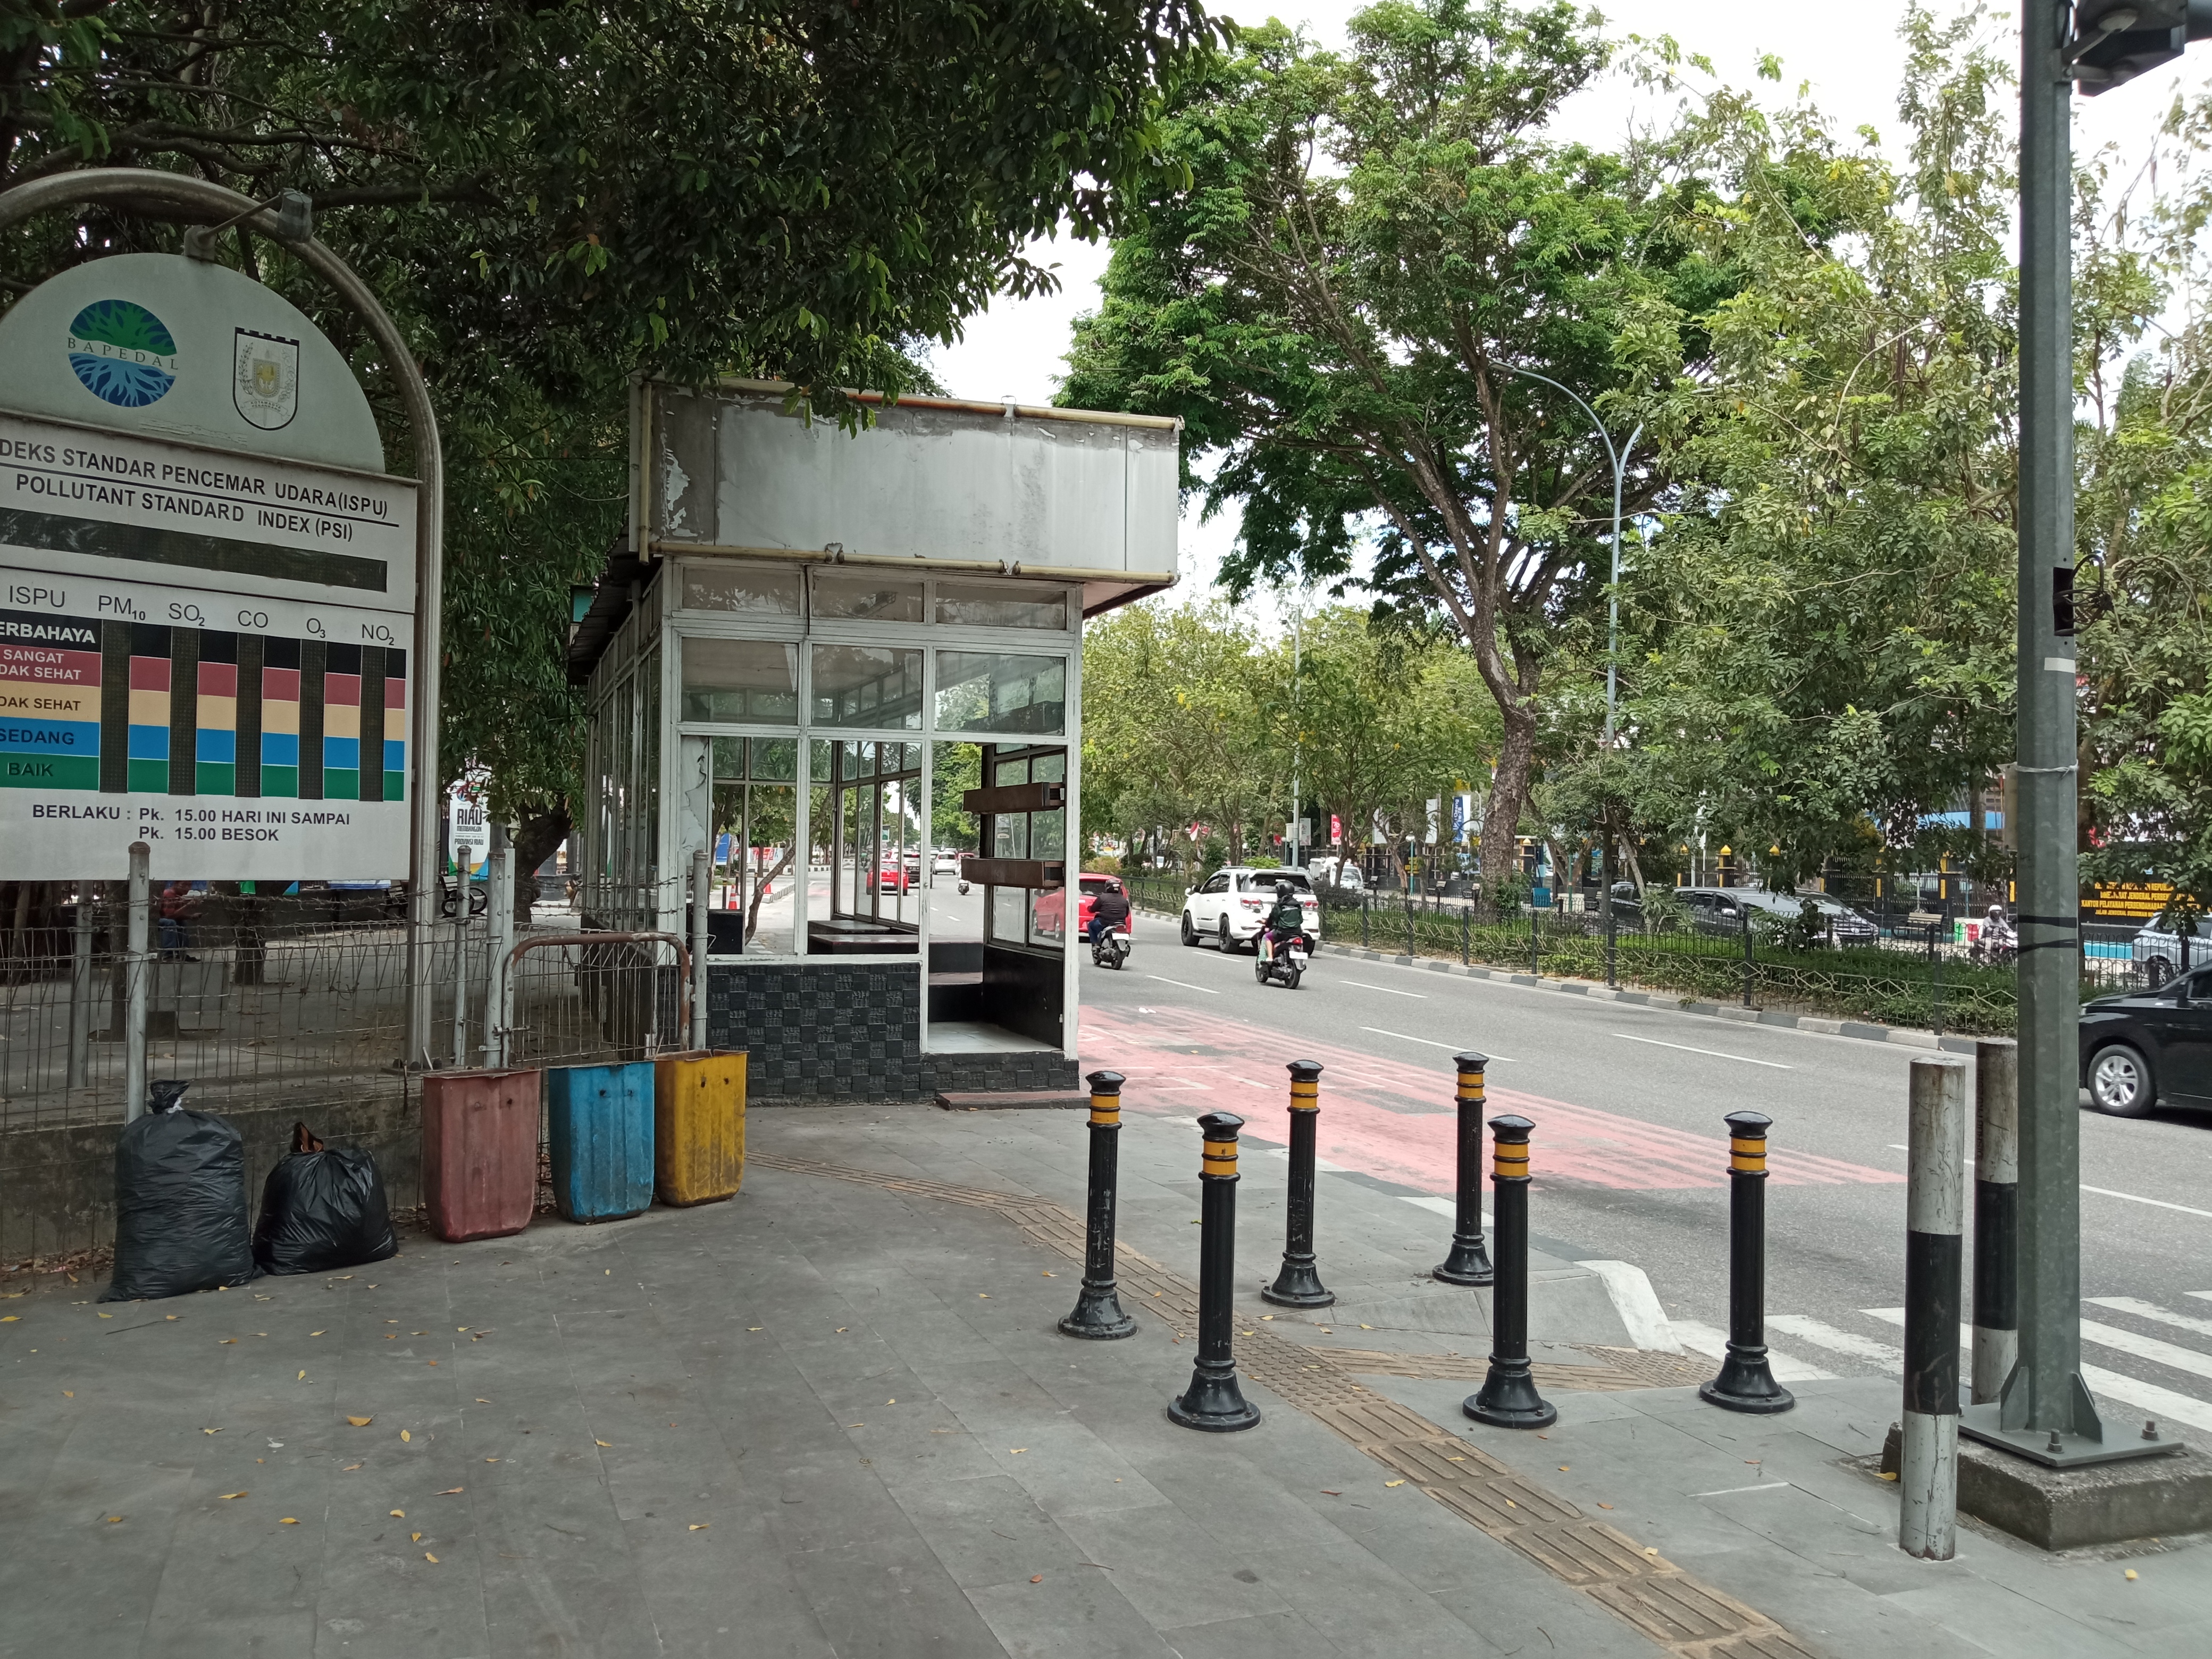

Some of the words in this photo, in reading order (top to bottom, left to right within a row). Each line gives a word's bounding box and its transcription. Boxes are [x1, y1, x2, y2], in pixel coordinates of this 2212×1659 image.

[68, 337, 178, 370] BAPEDAL
[0, 439, 55, 463] DEKS
[62, 448, 156, 479] STANDAR
[162, 464, 265, 495] PENCEMAR
[16, 474, 135, 507] POLLUTANT
[142, 493, 244, 522] STANDARD
[258, 509, 310, 533] INDEX
[316, 518, 353, 542] (PSI)
[10, 585, 65, 608] ISPU
[238, 610, 268, 628] CO
[3, 649, 64, 664] SANGAT
[33, 667, 81, 680] SEHAT
[33, 698, 81, 711] SEHAT
[0, 728, 74, 745] SEDANG
[7, 763, 53, 776] BAIK
[33, 805, 120, 819] BERLAKU
[139, 808, 164, 821] Pk.
[175, 809, 216, 822] 15.00
[222, 810, 261, 823] HARI
[266, 811, 286, 823] INI
[291, 812, 350, 825] SAMPAI
[457, 808, 482, 825] RIAU
[139, 826, 164, 839] Pk.
[174, 827, 216, 840] 15.00
[222, 828, 279, 841] BESOK
